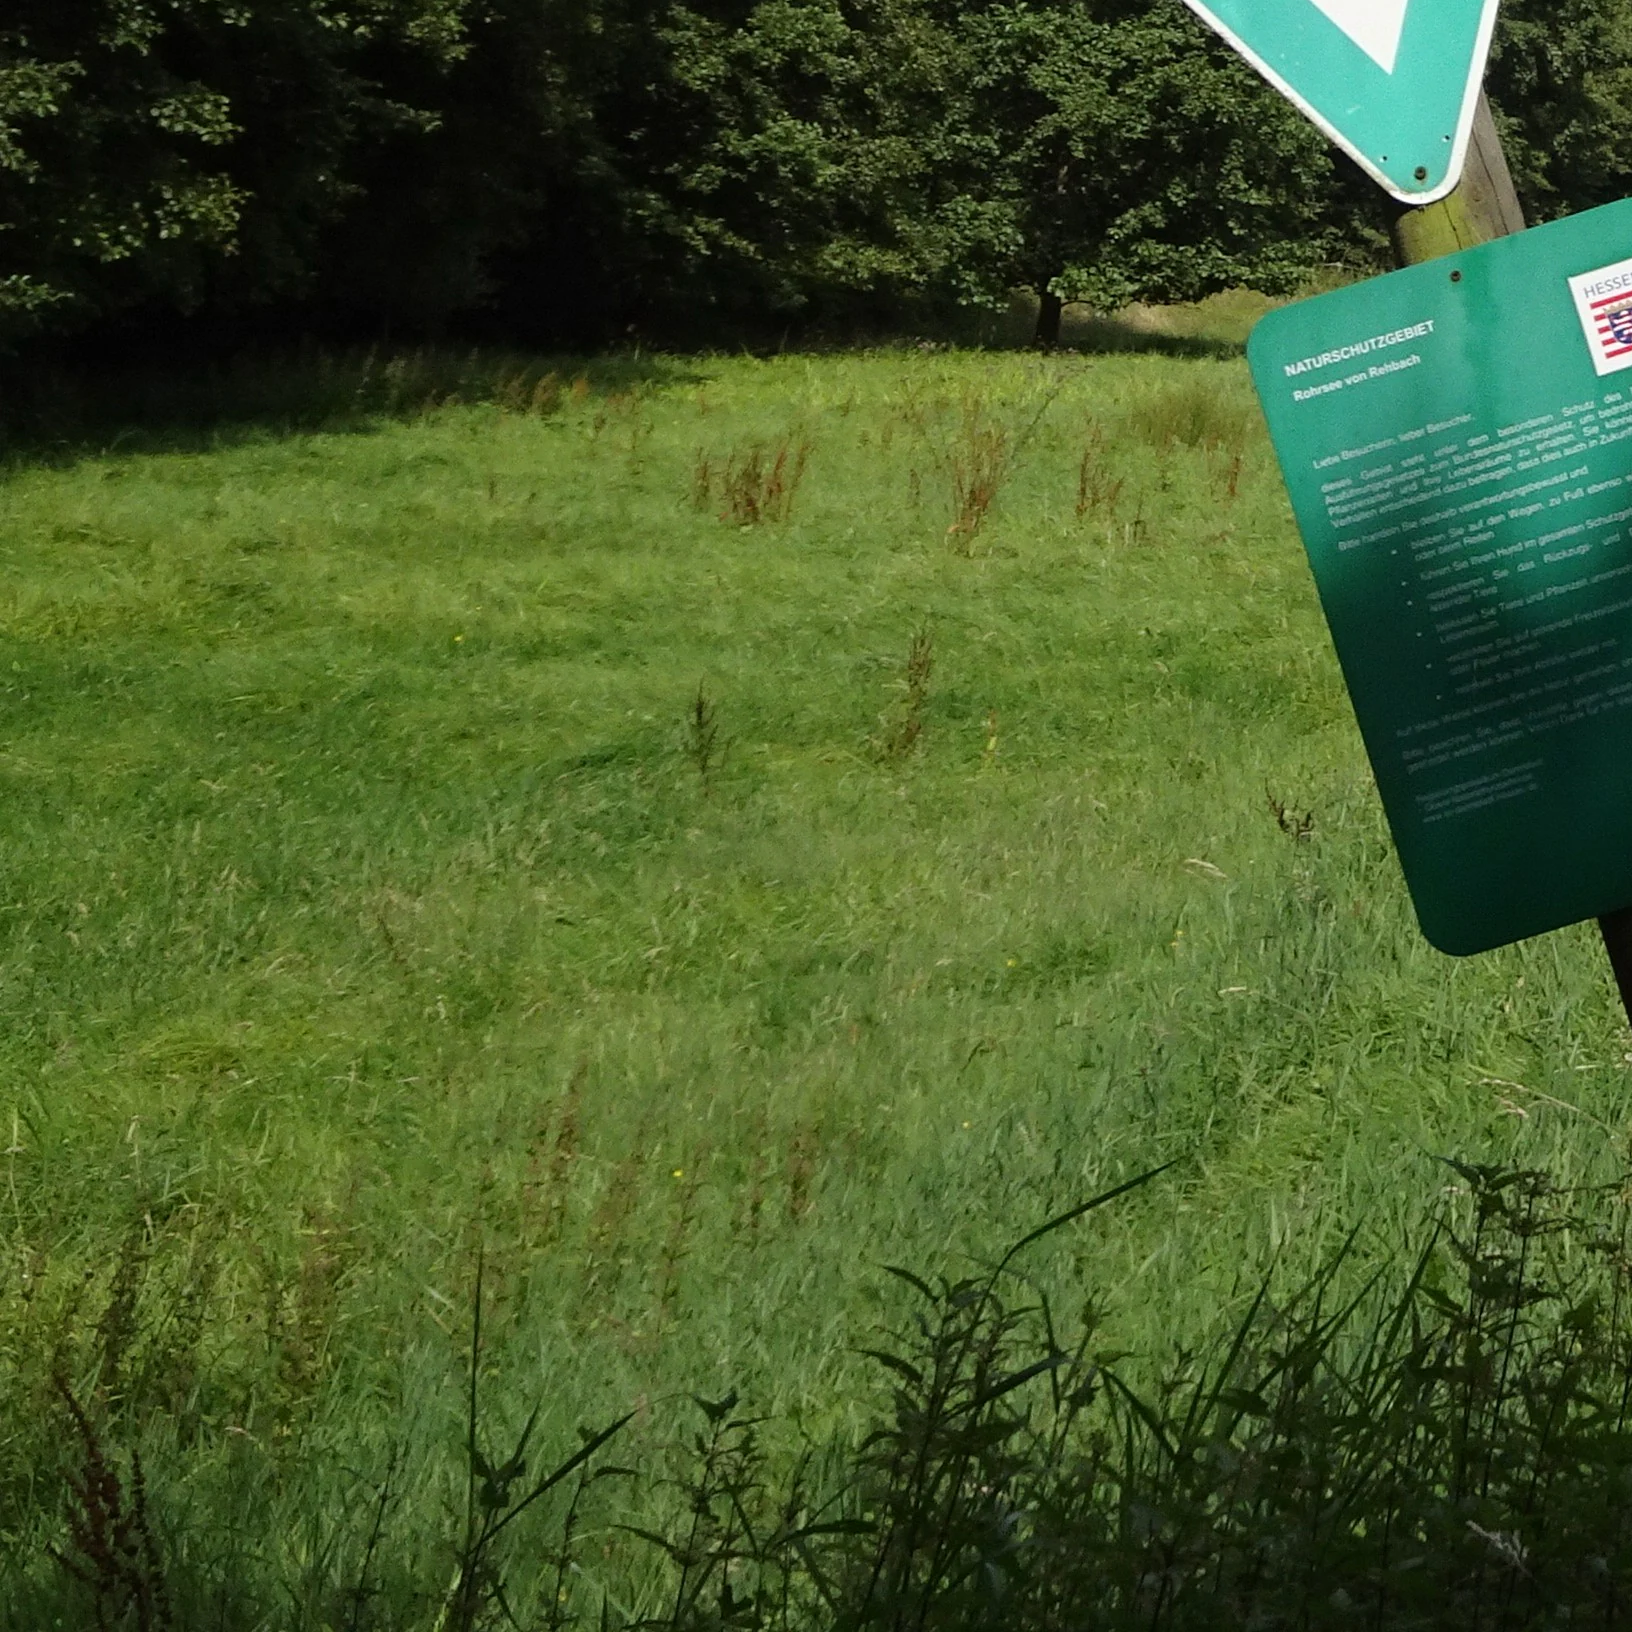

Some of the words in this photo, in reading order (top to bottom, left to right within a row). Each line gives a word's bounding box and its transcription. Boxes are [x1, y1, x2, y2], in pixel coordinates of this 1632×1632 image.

[1284, 320, 1435, 376] NATURSCHUTZGEBIET
[1293, 377, 1342, 401] Rohrsee
[1344, 370, 1366, 385] von
[1369, 353, 1420, 377] Rehbach
